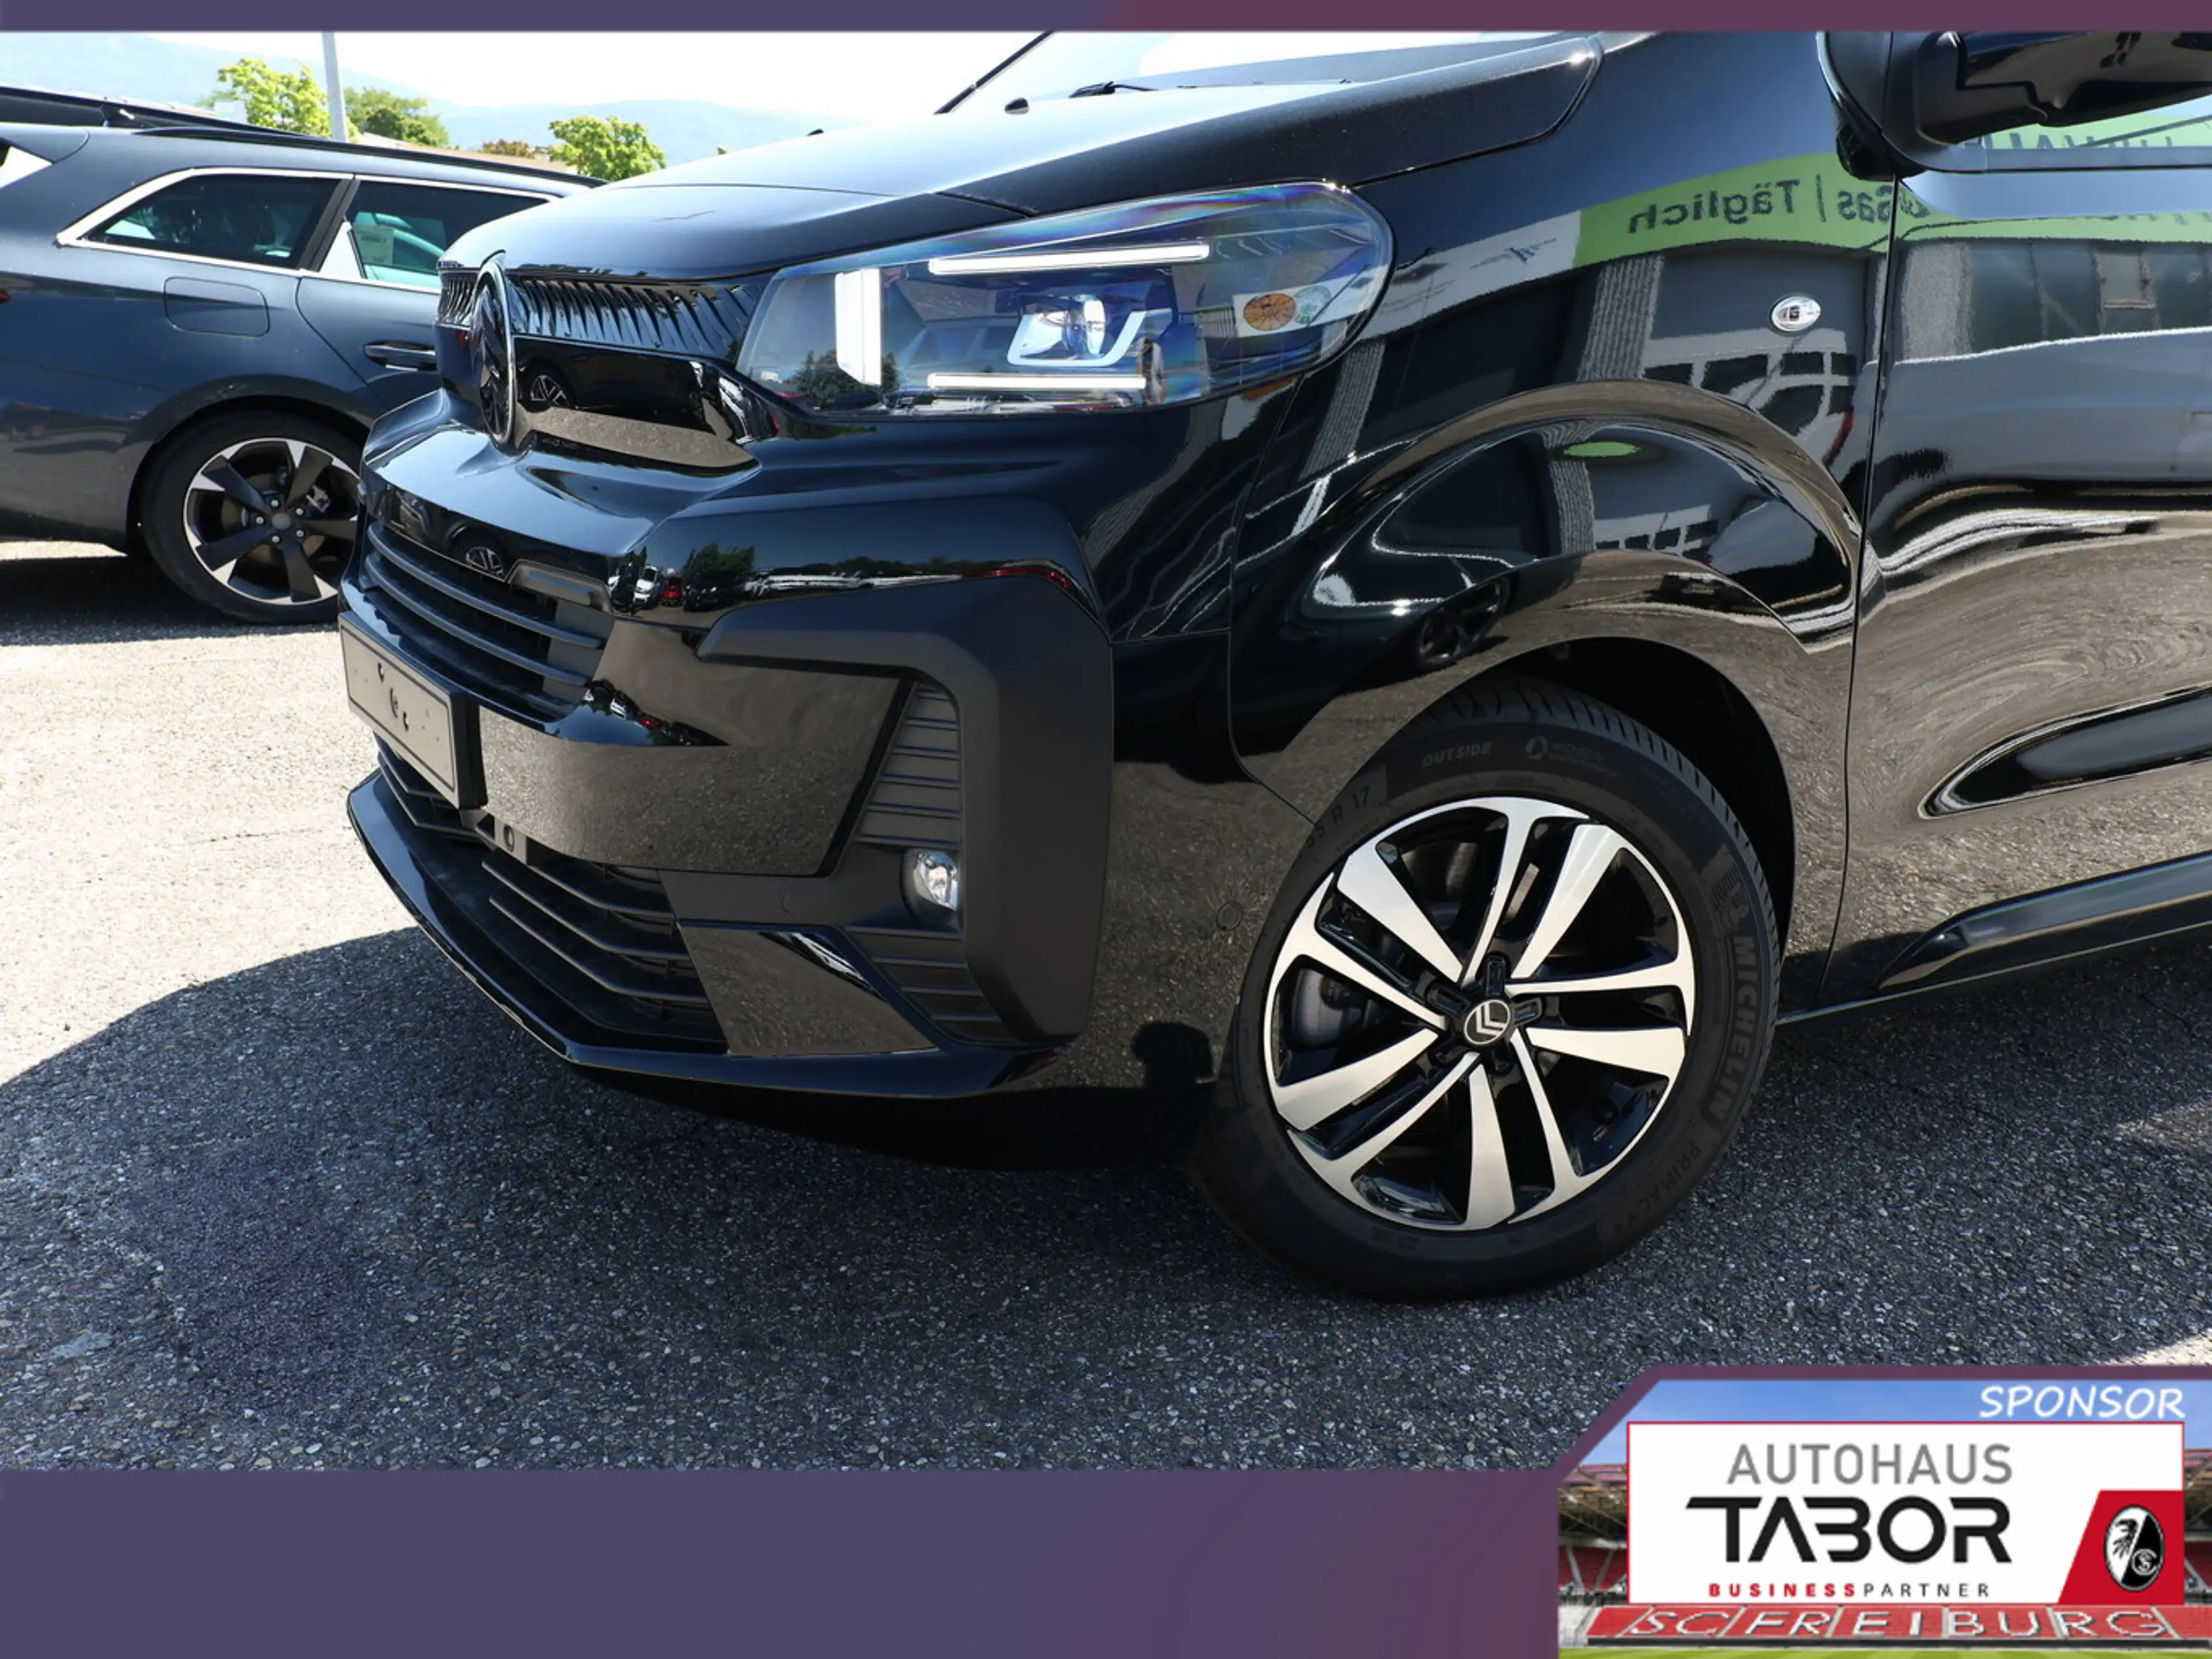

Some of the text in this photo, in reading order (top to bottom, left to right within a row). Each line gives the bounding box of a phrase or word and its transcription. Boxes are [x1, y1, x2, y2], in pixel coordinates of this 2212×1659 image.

[1422, 742, 1492, 768] OUTSIDE
[1330, 804, 1344, 825] R
[1351, 785, 1370, 811] 17
[1710, 935, 1760, 1123] MICHELIN
[1627, 1141, 1701, 1228] PRIMACY
